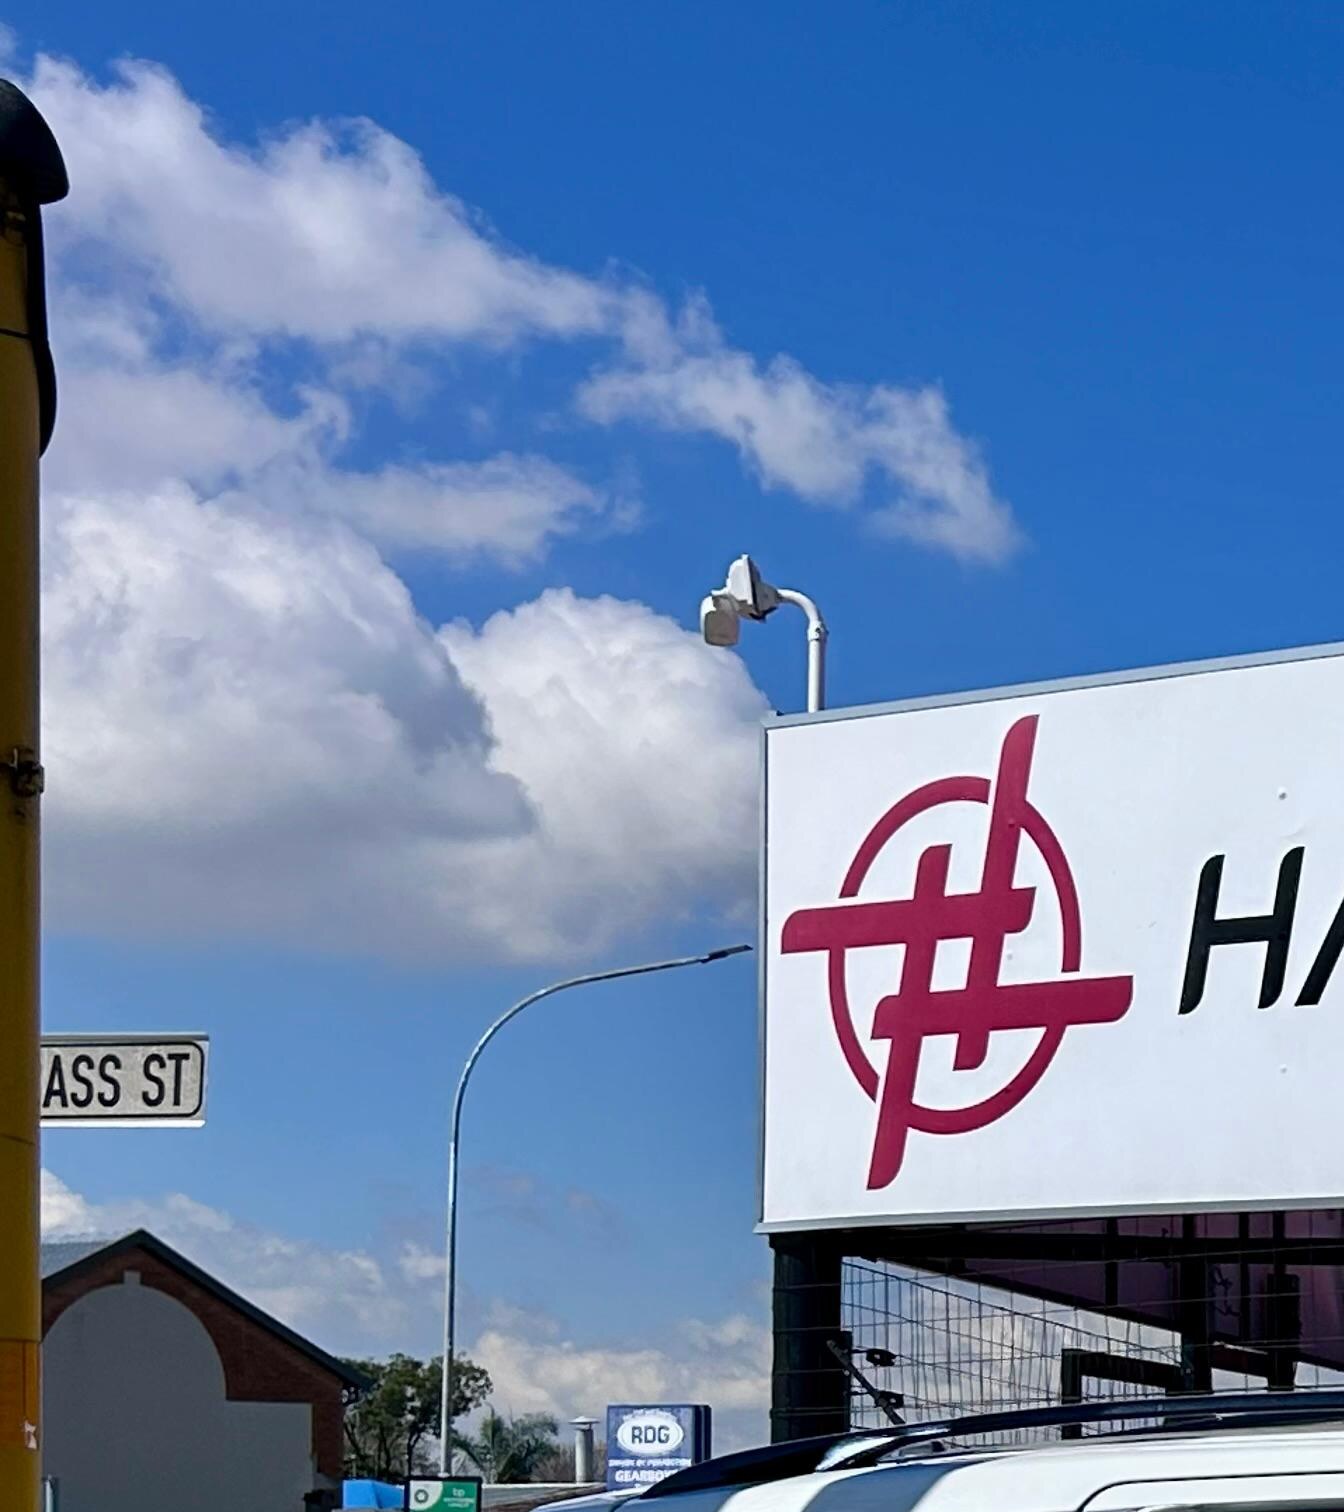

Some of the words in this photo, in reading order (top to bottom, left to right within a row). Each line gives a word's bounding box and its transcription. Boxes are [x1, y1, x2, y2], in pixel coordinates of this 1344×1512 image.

[42, 1054, 122, 1108] ASS
[142, 1053, 191, 1107] ST
[631, 1425, 670, 1444] RDG
